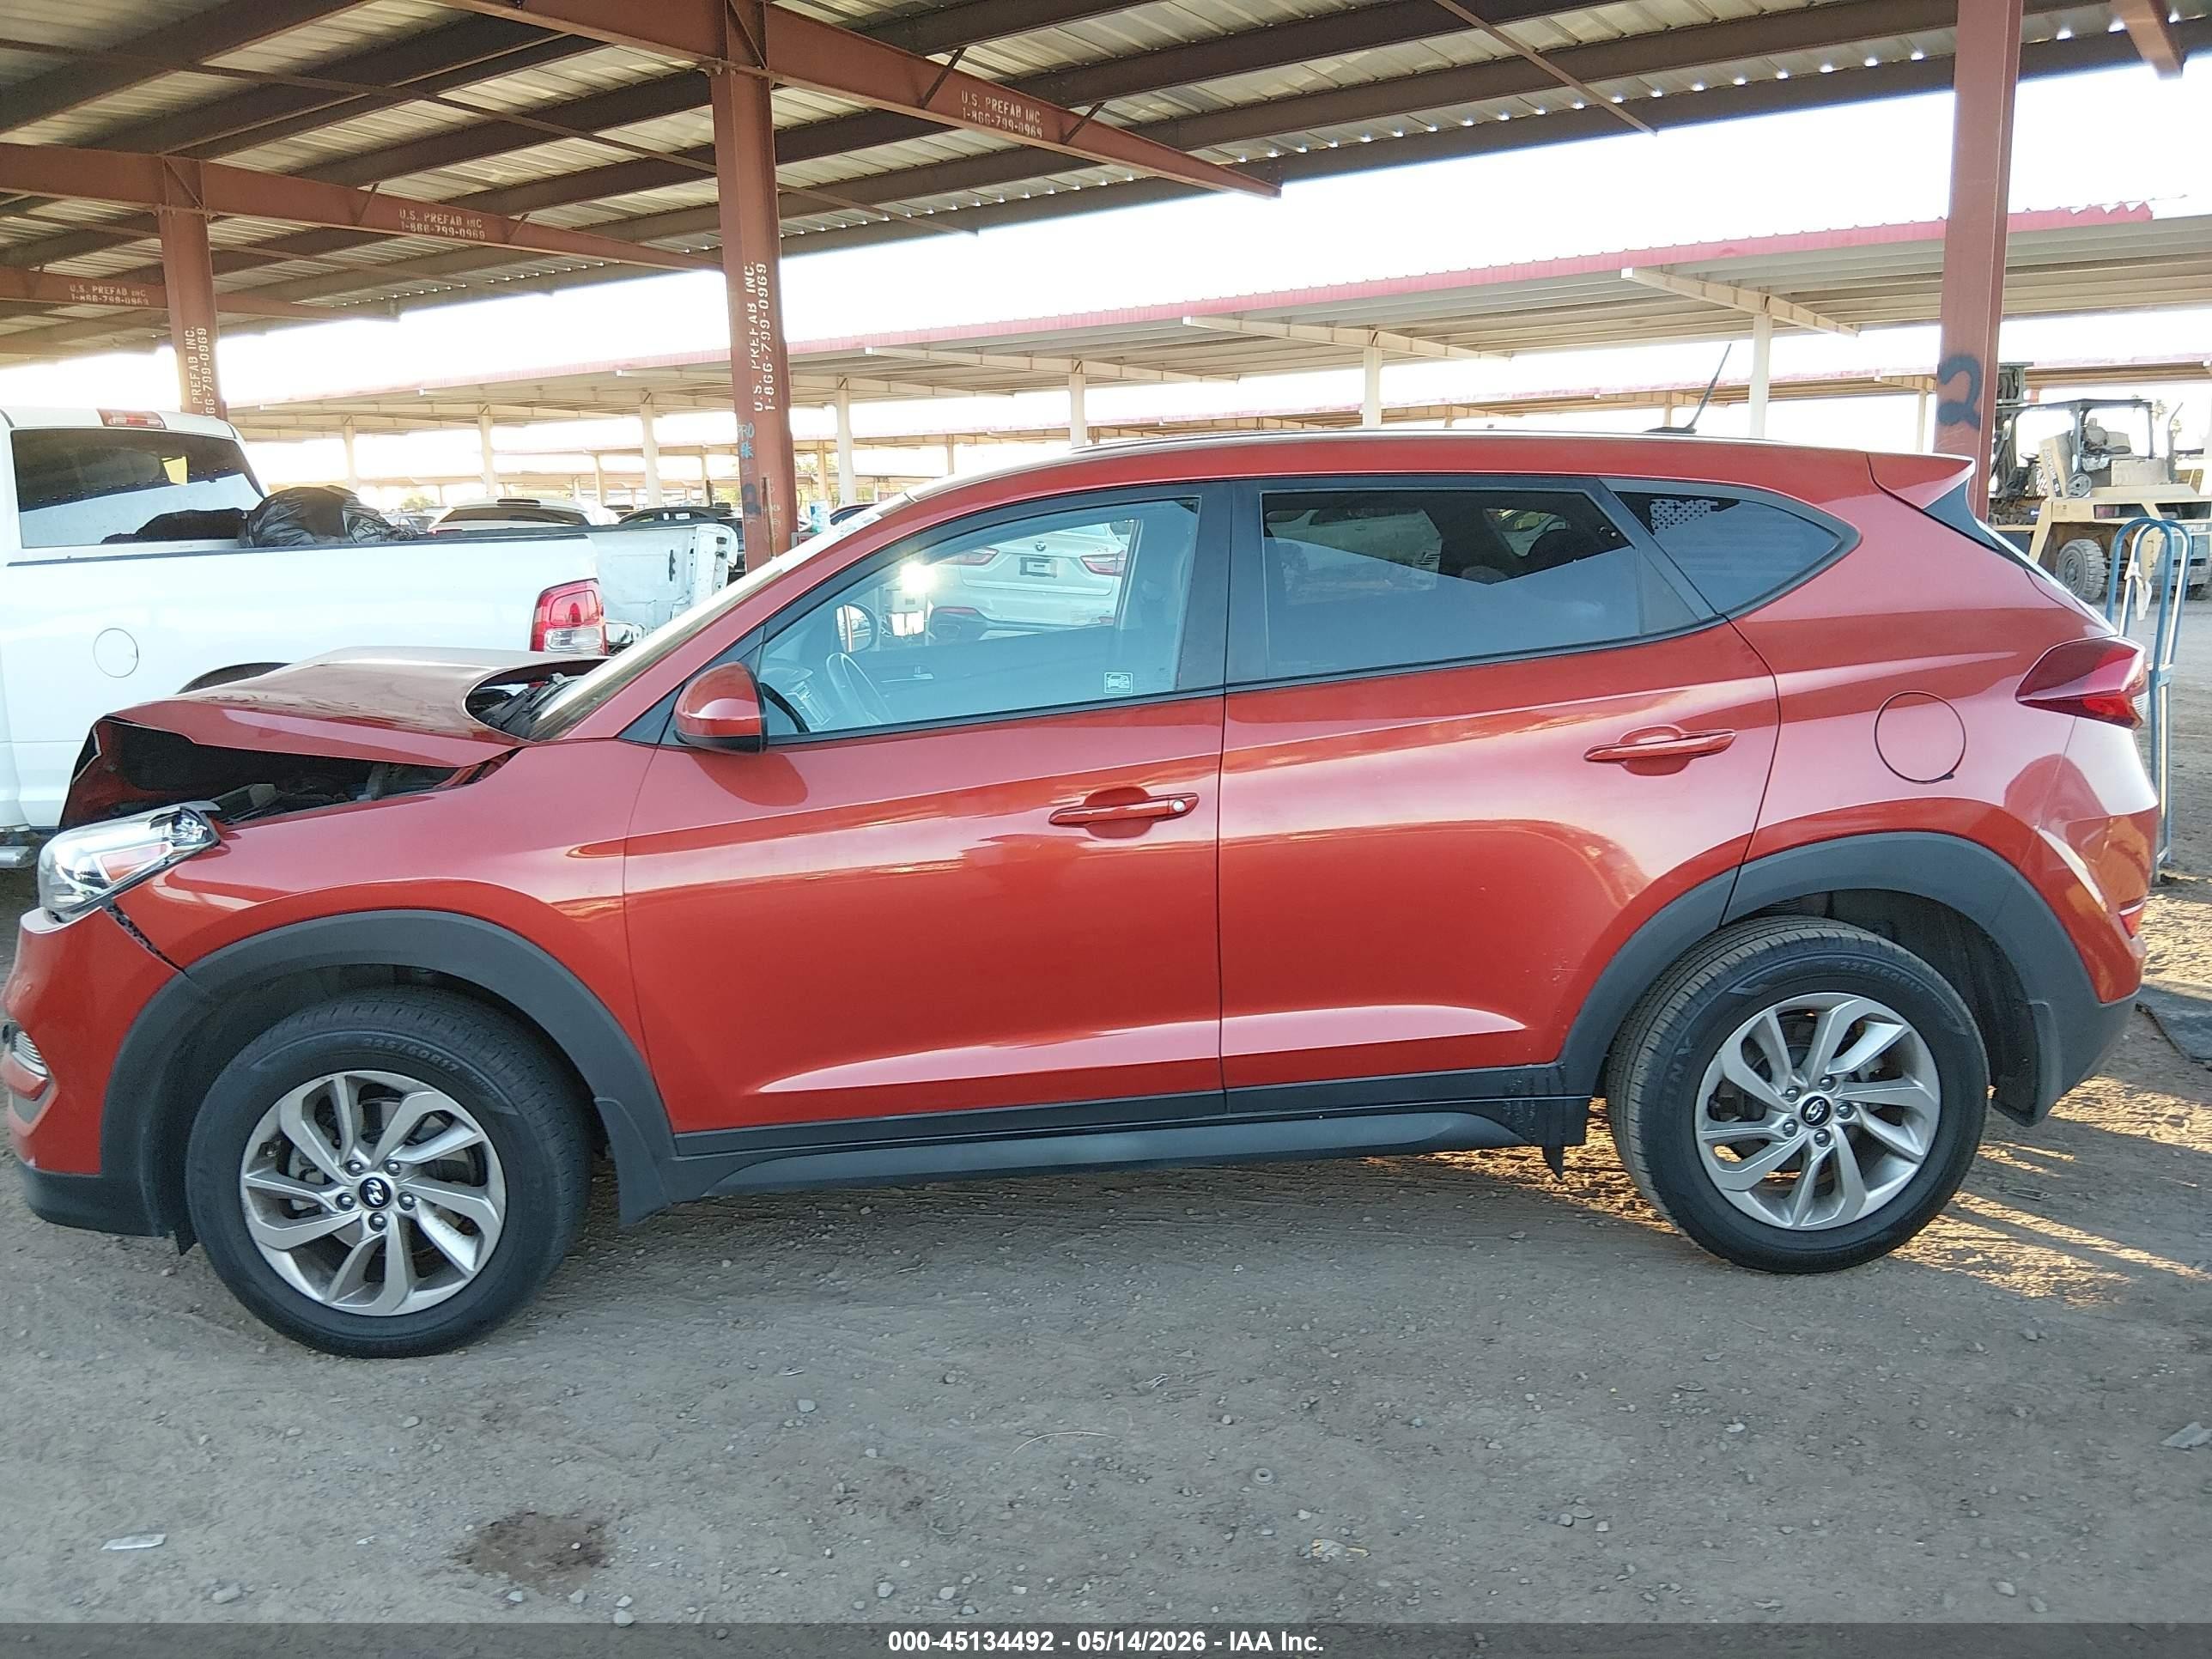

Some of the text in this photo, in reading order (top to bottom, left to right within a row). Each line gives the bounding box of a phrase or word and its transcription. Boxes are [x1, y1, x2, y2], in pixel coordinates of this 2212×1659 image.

[961, 89, 981, 107] U.S.
[985, 96, 1022, 118] PREFAB
[962, 106, 1043, 138] 1-866-799-0969
[399, 209, 420, 222] U.S.
[423, 212, 462, 226] PREFAB
[92, 285, 128, 296] PREFAB
[185, 326, 197, 349] INC.
[744, 261, 763, 412] U.S. PREFAB INC.
[756, 263, 776, 412] 1-866-799-0969
[187, 356, 204, 404] PREFAB
[1937, 355, 1981, 429] 2
